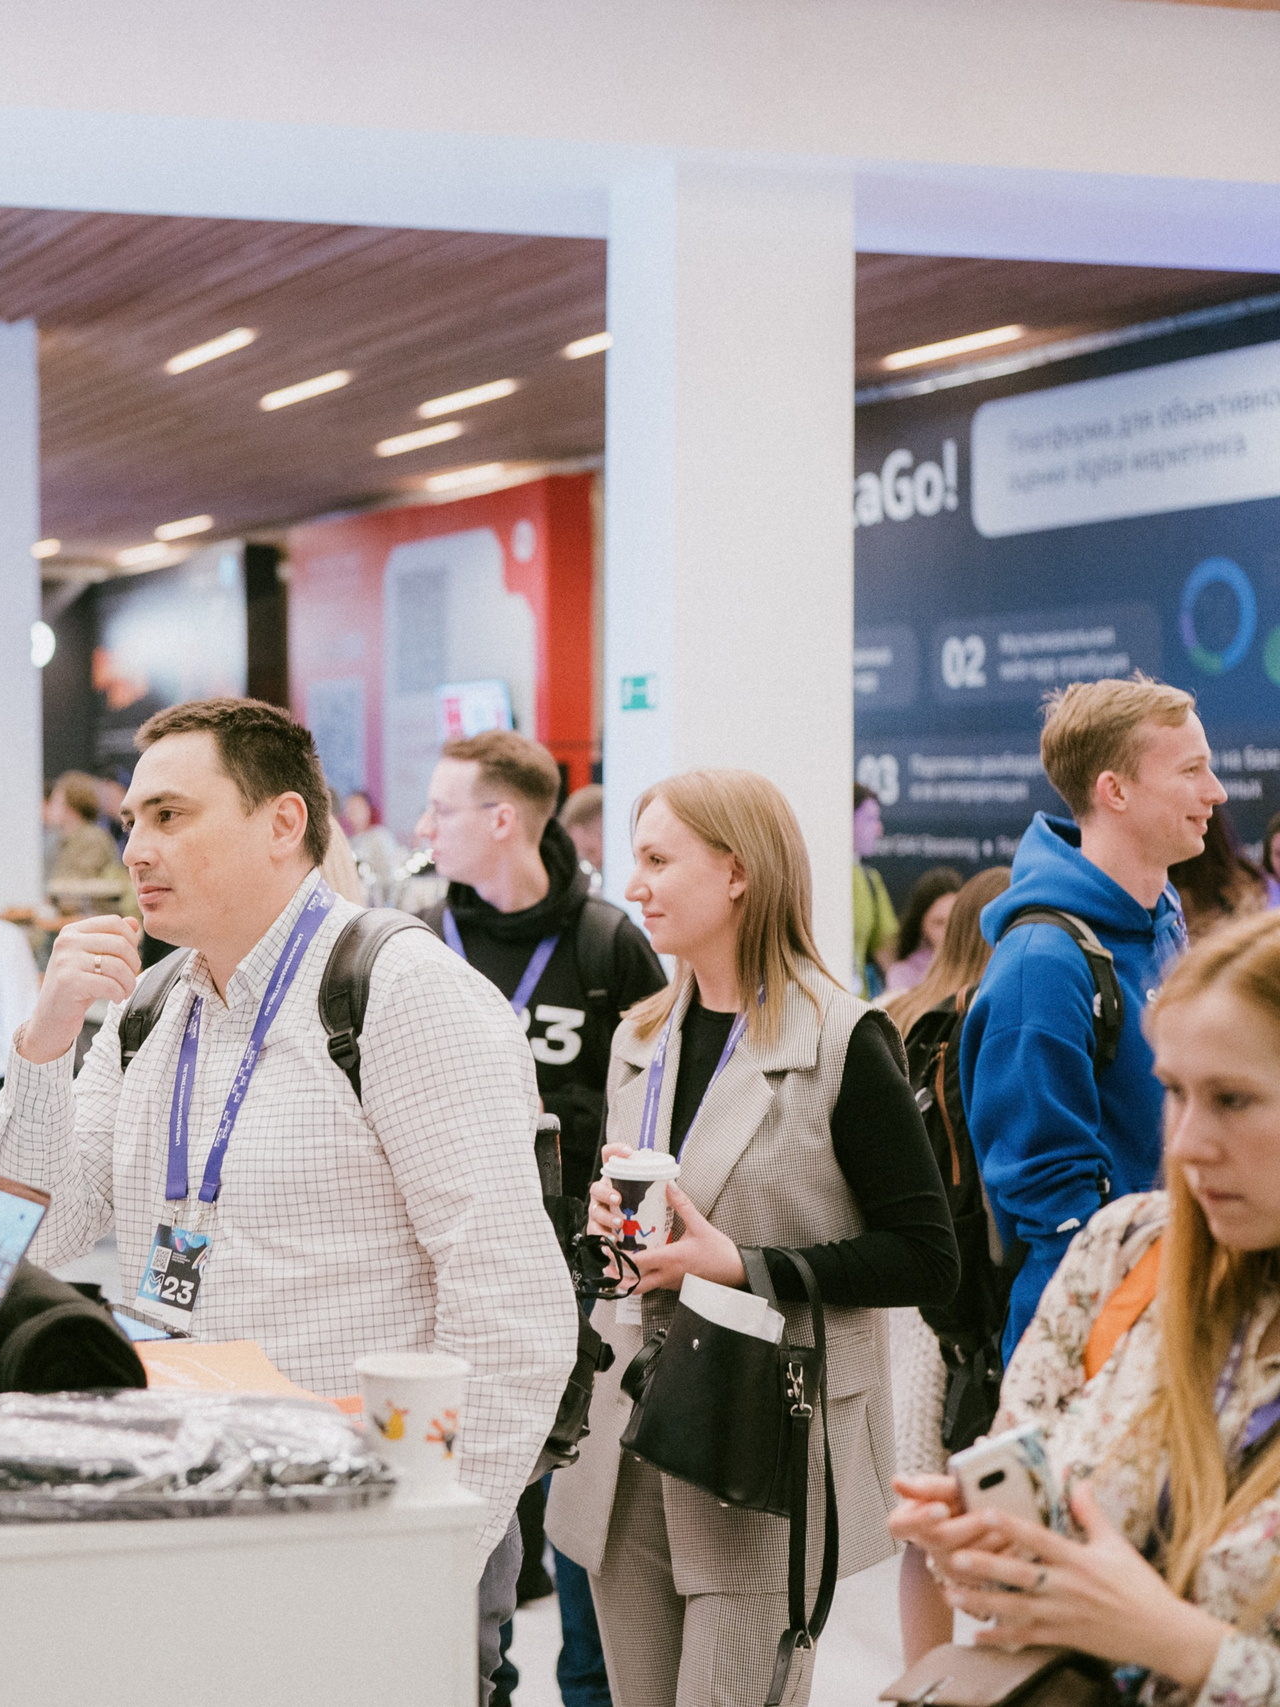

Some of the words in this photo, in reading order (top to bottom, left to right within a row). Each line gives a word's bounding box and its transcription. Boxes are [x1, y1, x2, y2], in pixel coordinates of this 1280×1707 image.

[854, 438, 958, 528] aGo!
[941, 634, 987, 690] 02
[518, 1003, 586, 1066] 3
